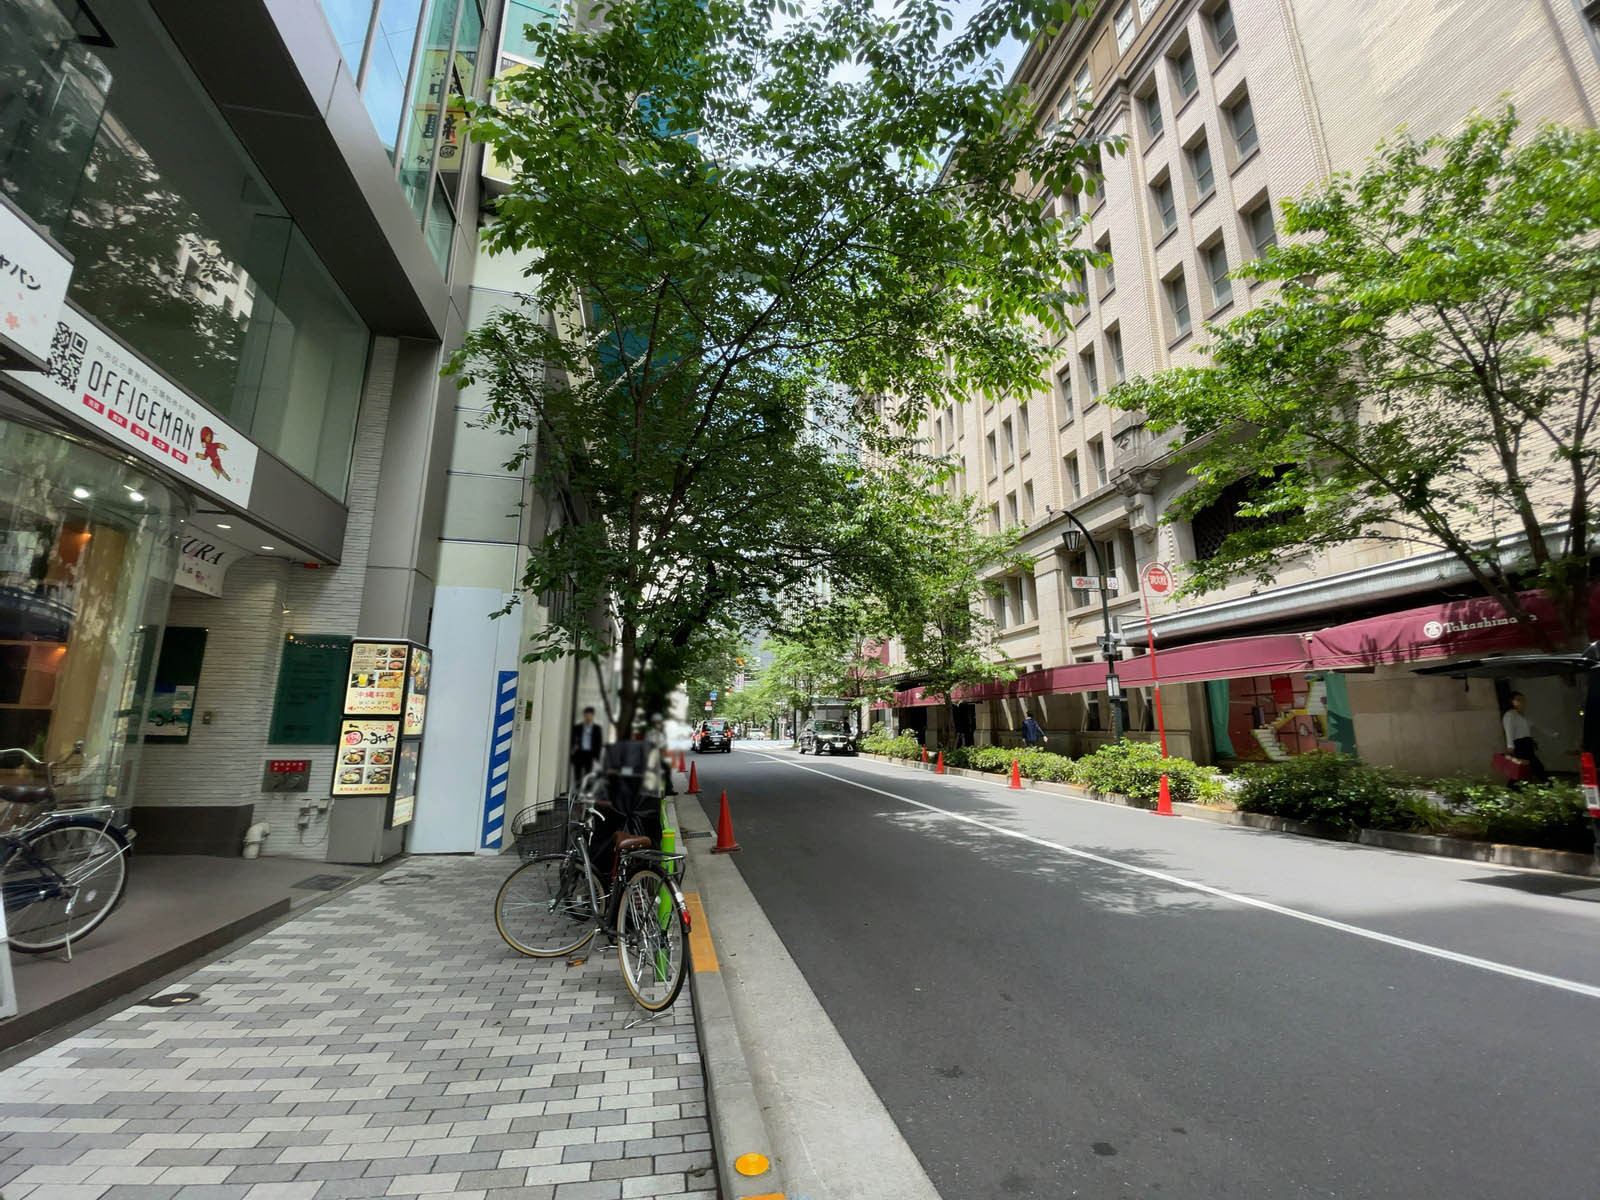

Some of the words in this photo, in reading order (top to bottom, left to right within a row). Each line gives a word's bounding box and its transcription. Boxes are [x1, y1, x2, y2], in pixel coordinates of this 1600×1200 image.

[88, 360, 195, 451] OFFICEMAN
[182, 535, 225, 566] URA
[1443, 614, 1538, 633] Takashimaa
